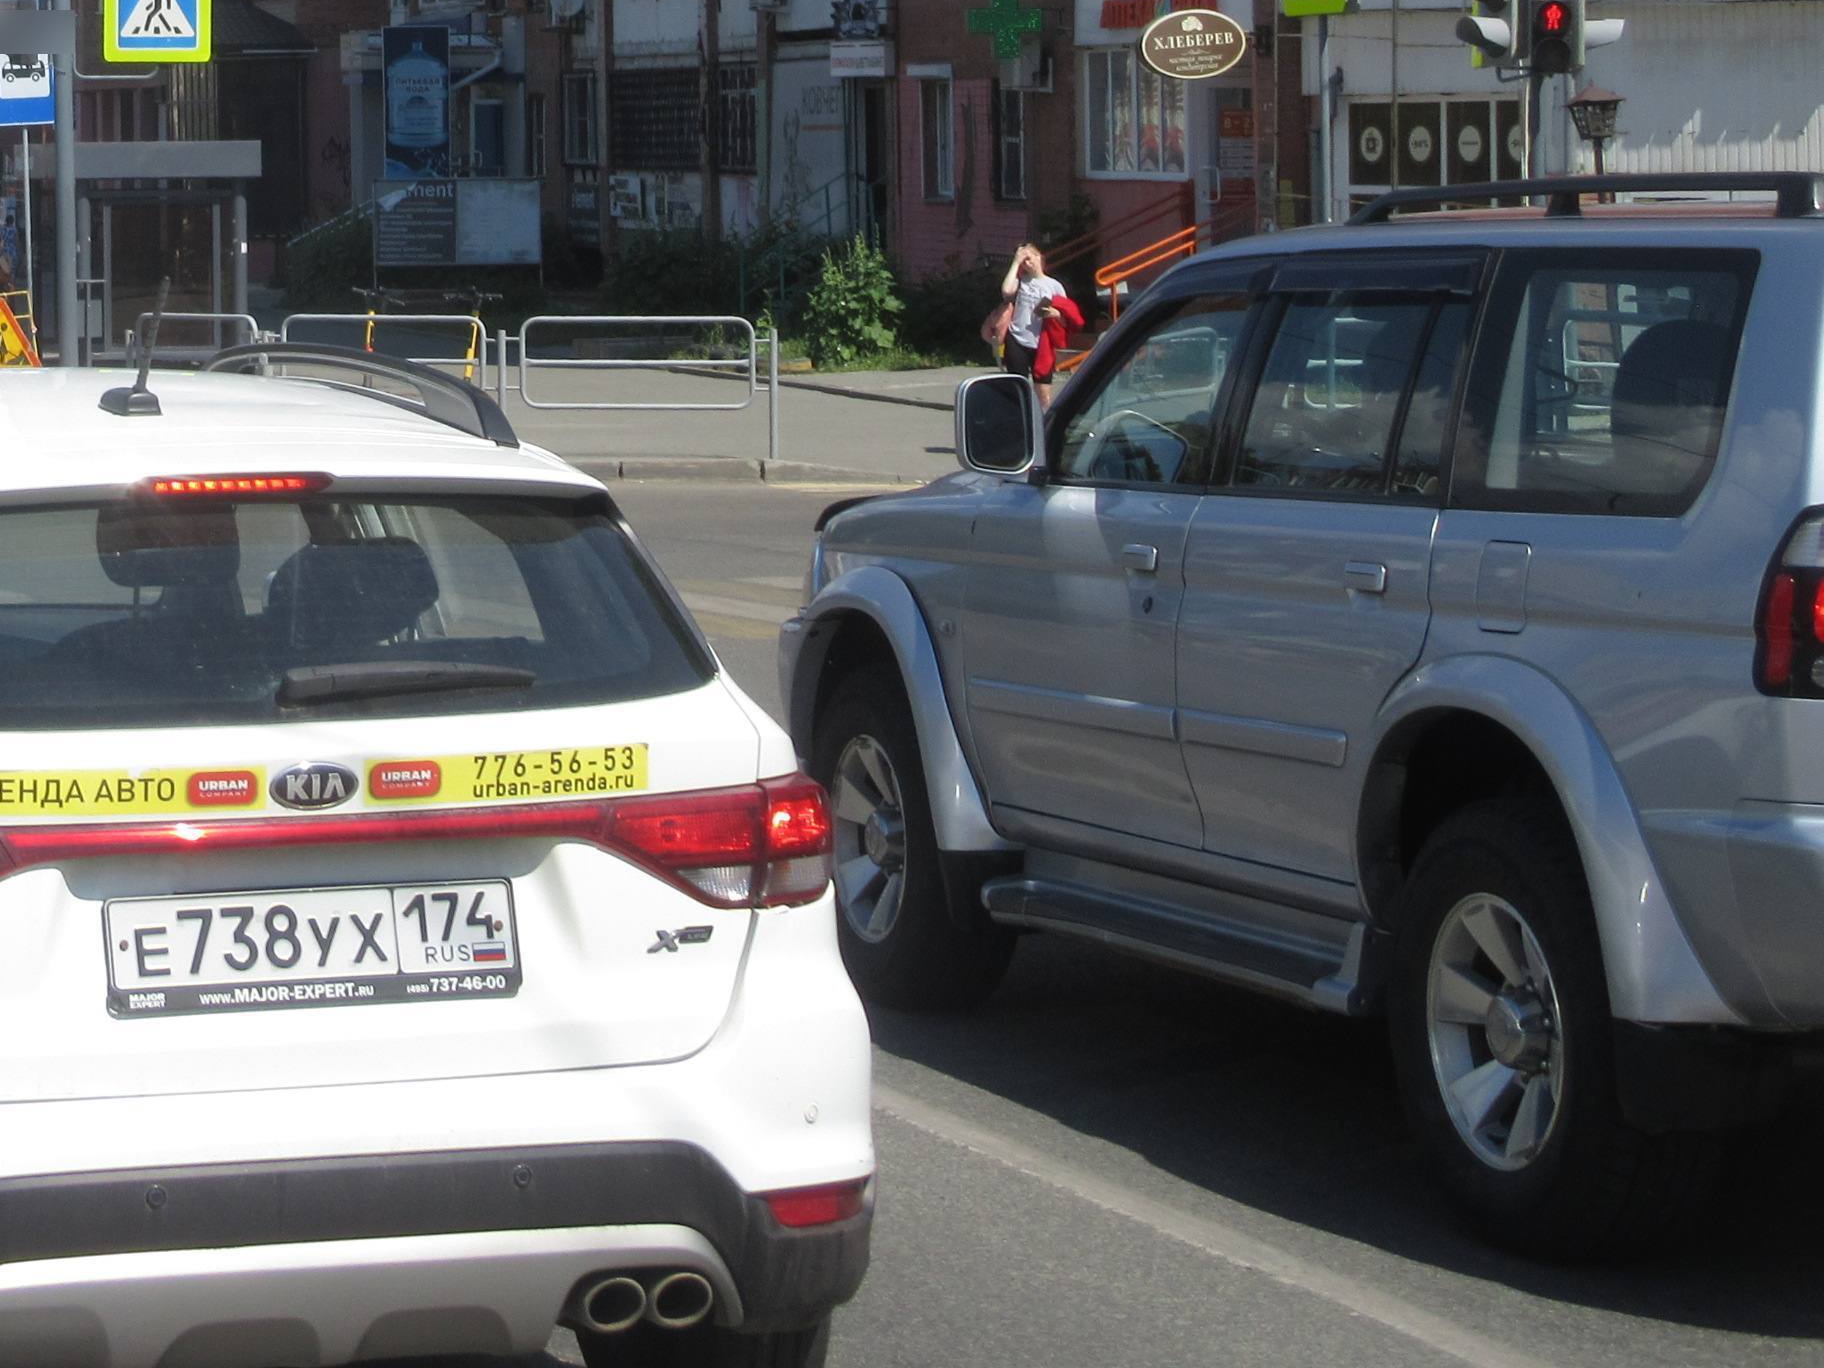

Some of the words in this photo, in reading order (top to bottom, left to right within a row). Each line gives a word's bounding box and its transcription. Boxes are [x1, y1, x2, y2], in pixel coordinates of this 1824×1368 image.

[1153, 32, 1234, 50] ХЛЕБЕРЕВ
[474, 746, 635, 780] 776-56-53
[199, 779, 248, 790] URBAN
[381, 769, 432, 782] URBAN
[94, 778, 175, 803] АВТО
[286, 775, 349, 800] KIA
[473, 773, 635, 799] urban-arenda.ru
[402, 892, 495, 942] 174
[425, 944, 471, 964] RUS
[430, 975, 506, 993] 737-46-00
[129, 993, 166, 1002] MAJOR
[129, 1000, 166, 1009] EXPERT
